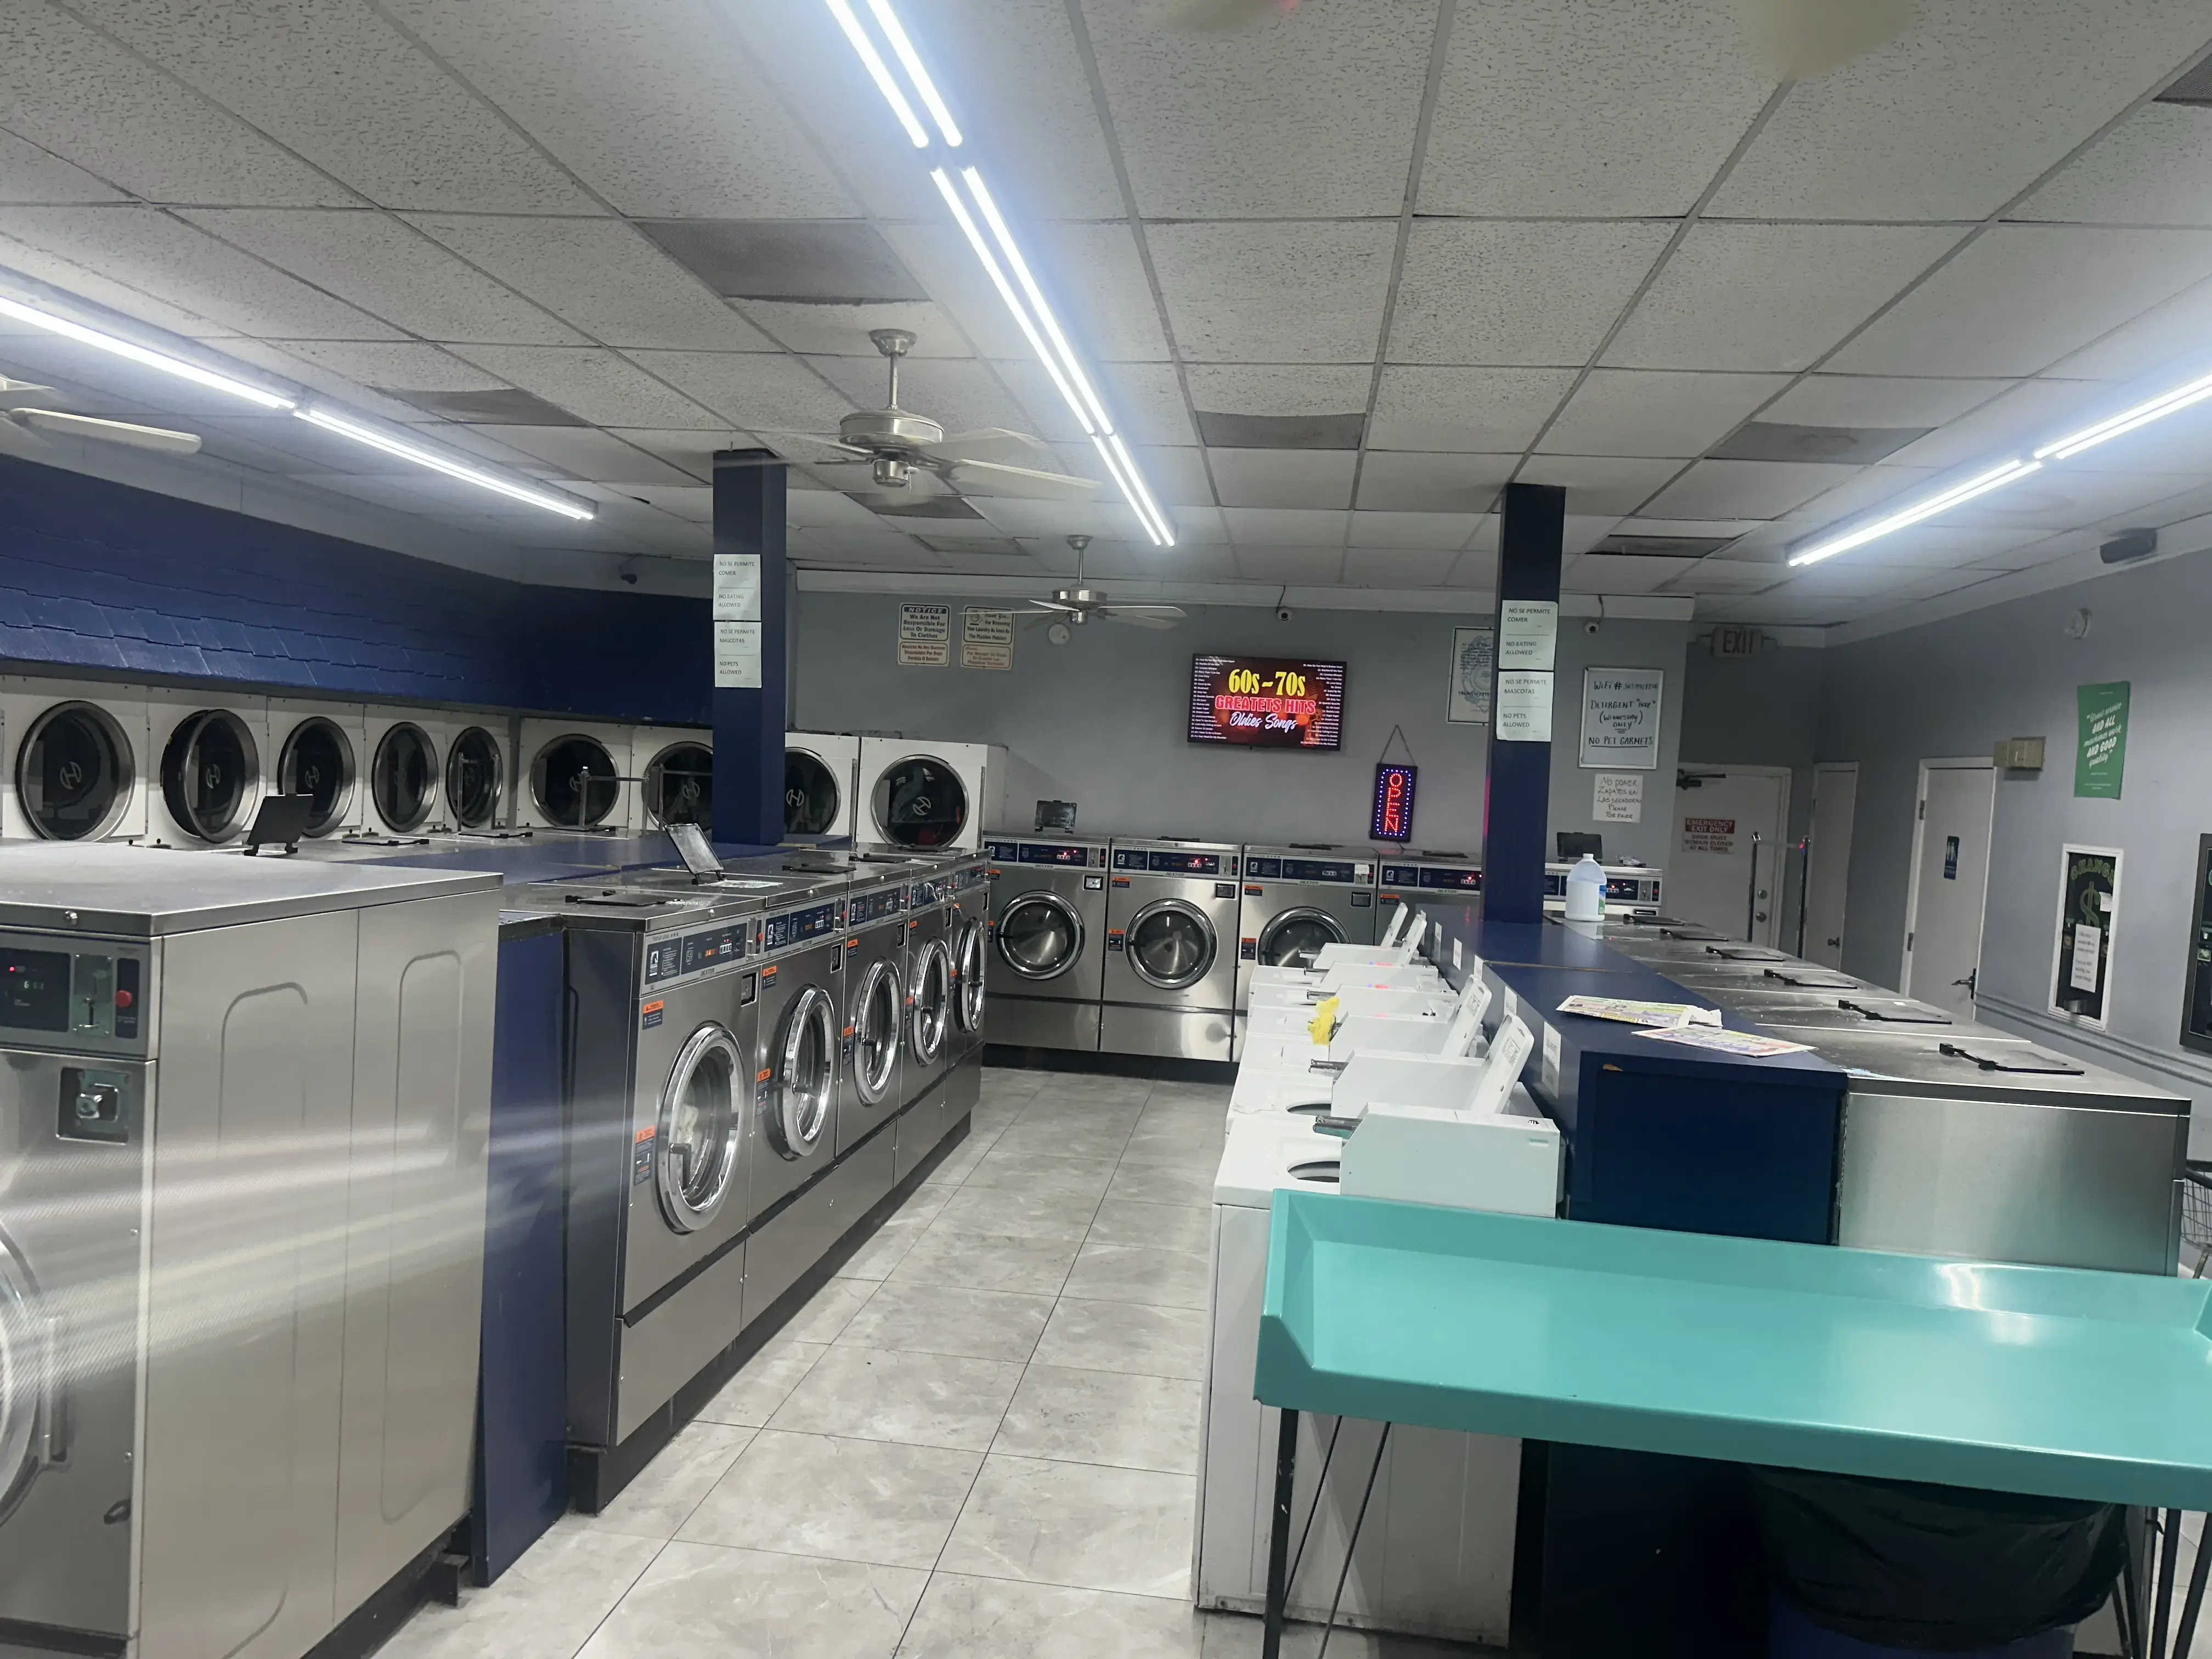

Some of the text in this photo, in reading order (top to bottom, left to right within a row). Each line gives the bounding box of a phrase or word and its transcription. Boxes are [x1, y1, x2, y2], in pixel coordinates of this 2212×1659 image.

[1723, 631, 1754, 654] EXIT
[1215, 696, 1316, 714] GREATETS HITS
[1591, 700, 1634, 709] DETERGENT
[1229, 712, 1262, 727] Oldies
[1265, 713, 1298, 733] Songs
[2092, 715, 2115, 734] AND ALL
[2087, 736, 2117, 757] AND GOOD
[1384, 773, 1402, 833] OPEN
